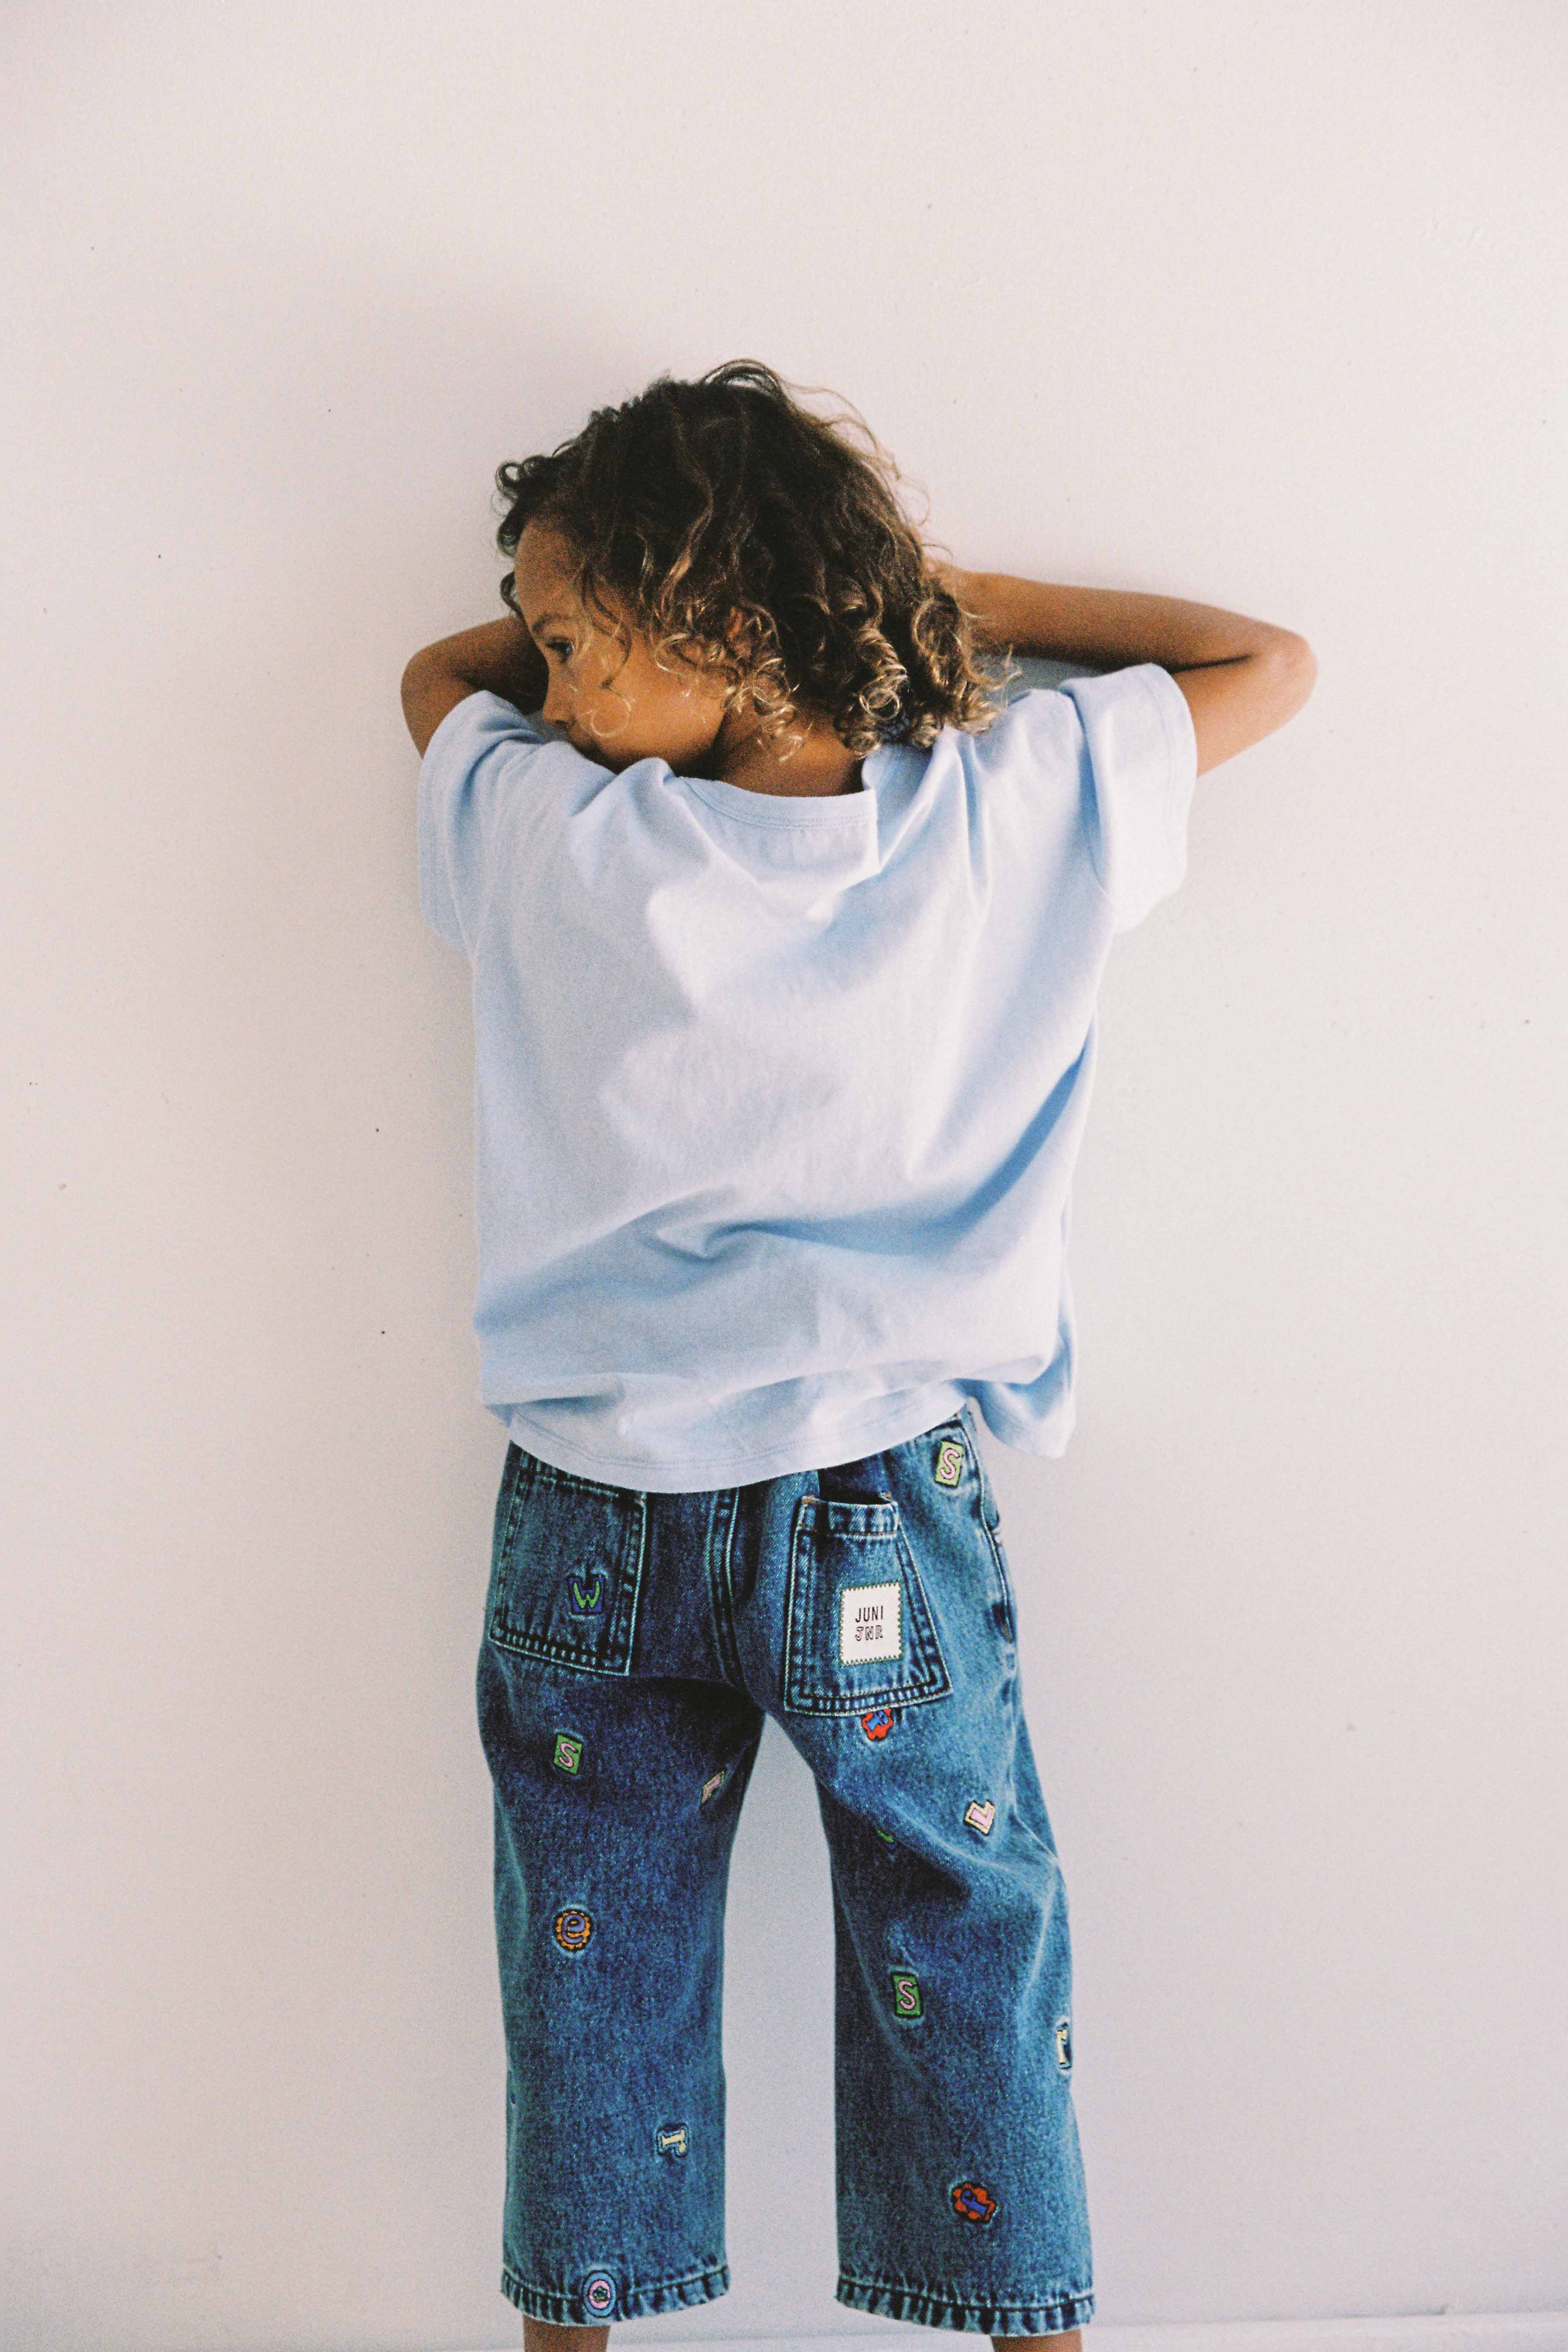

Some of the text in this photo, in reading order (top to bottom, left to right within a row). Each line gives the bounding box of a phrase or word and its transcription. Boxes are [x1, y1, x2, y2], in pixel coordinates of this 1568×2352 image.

[940, 1447, 960, 1480] S
[855, 1605, 883, 1622] JUNI
[855, 1625, 883, 1641] JNR
[559, 1742, 576, 1768] S
[562, 1914, 586, 1944] e
[898, 1979, 916, 2010] S
